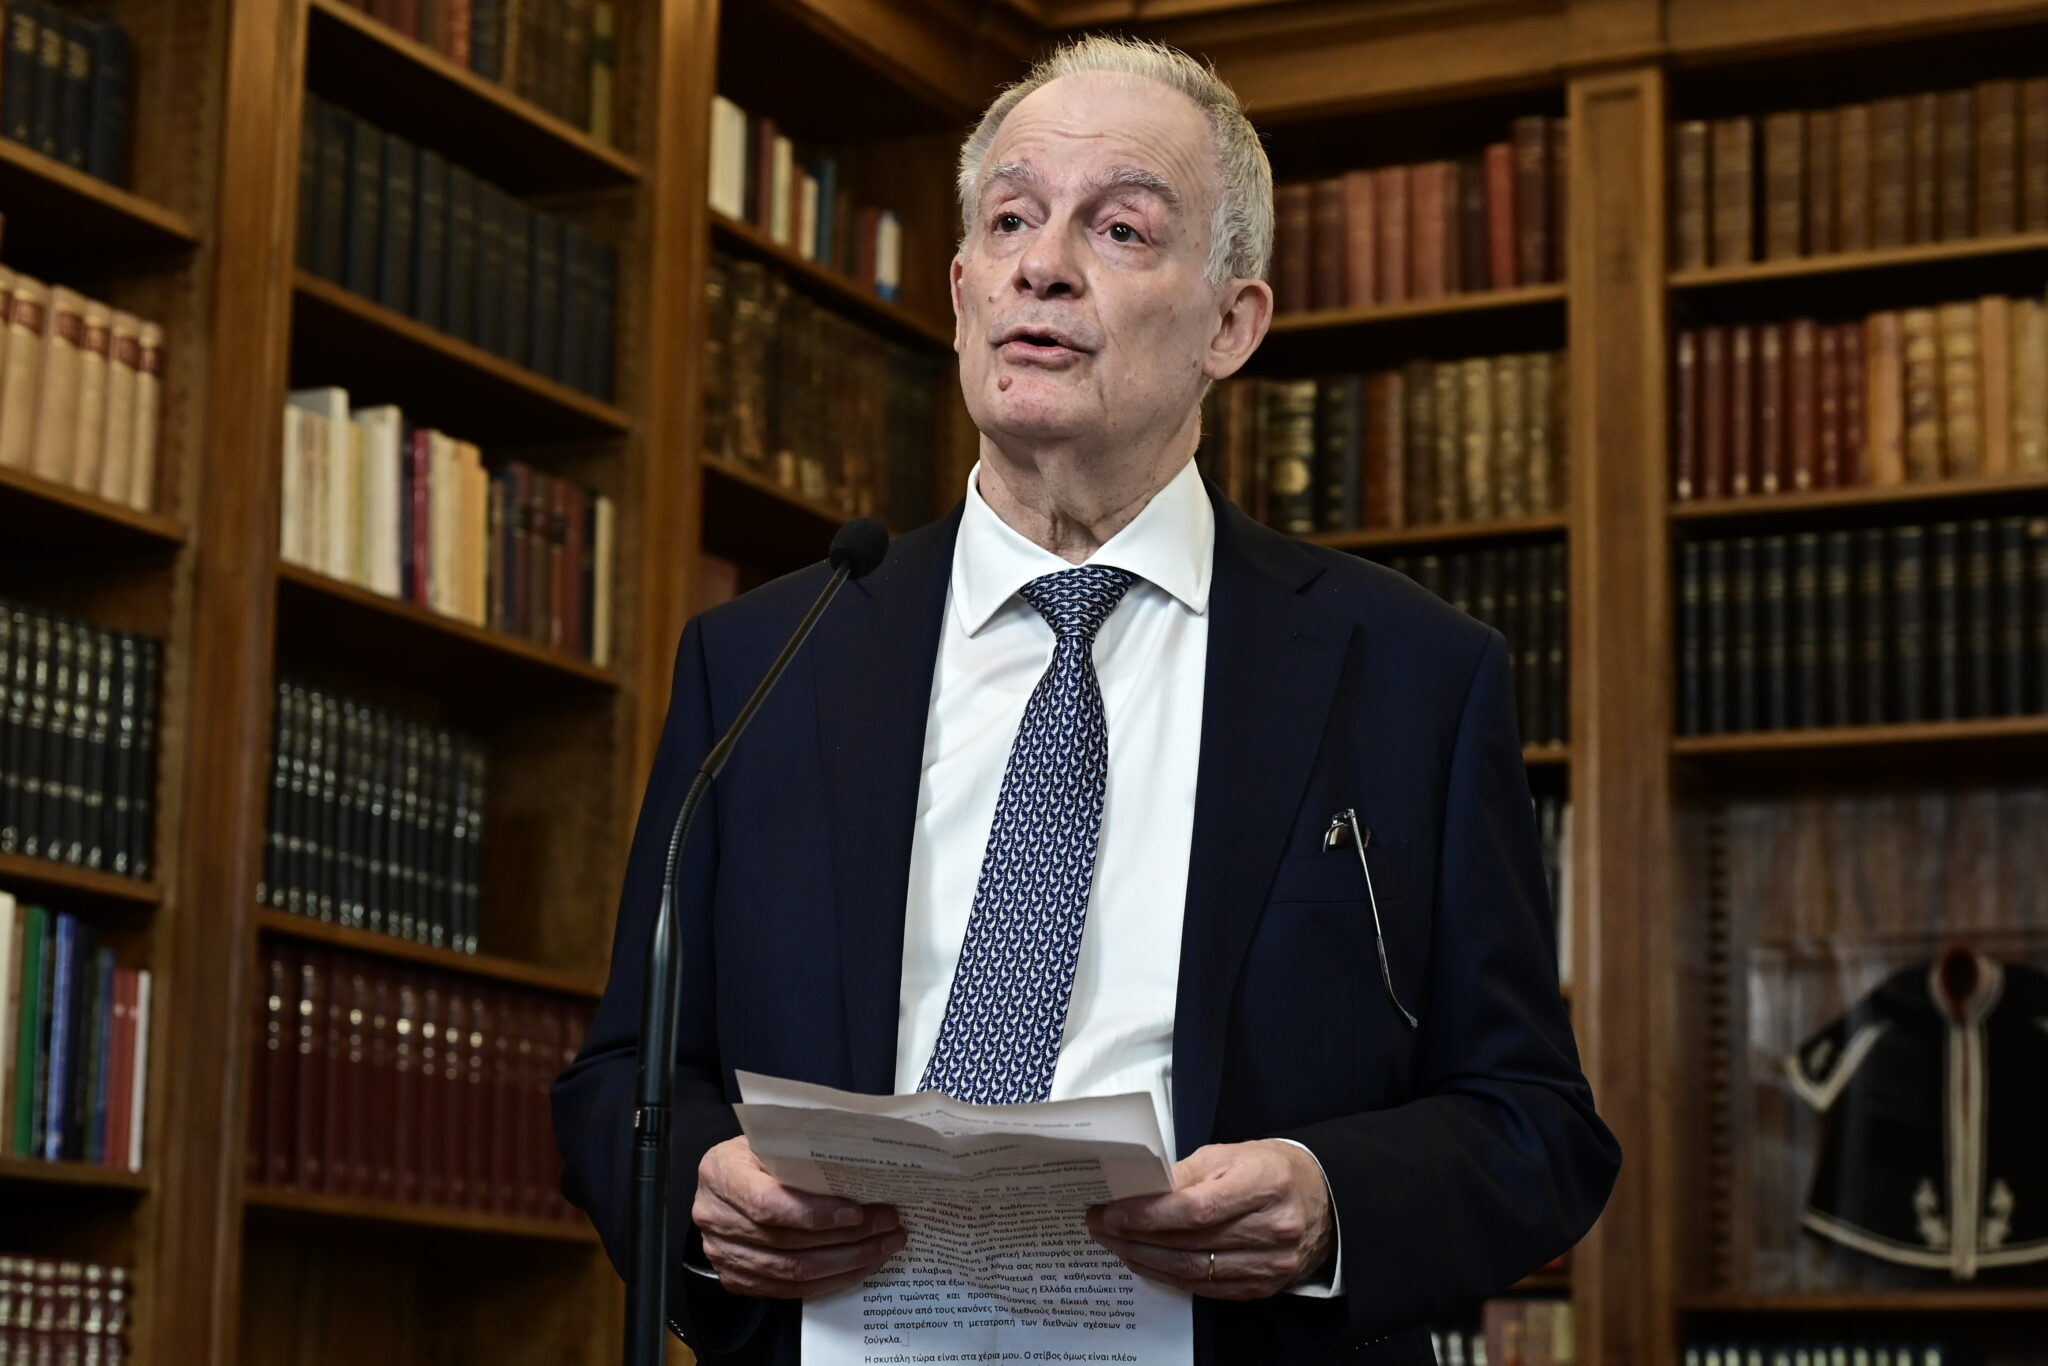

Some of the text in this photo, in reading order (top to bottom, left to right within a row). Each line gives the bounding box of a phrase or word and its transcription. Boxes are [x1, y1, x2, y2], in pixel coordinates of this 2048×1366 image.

[970, 1239, 987, 1247] στο
[974, 1244, 997, 1255] είναι
[1041, 1239, 1064, 1247] αλλά
[1066, 1239, 1082, 1248] την
[1022, 1248, 1071, 1259] λειτουργός
[1073, 1249, 1084, 1257] σε
[908, 1255, 921, 1264] για
[990, 1260, 1014, 1271] λόγια
[1016, 1262, 1033, 1271] σας
[1055, 1261, 1066, 1269] τα
[1068, 1259, 1099, 1269] κάνατε
[912, 1266, 953, 1276] ευλαβικά
[974, 1273, 1034, 1282] συνταγματικά
[1040, 1274, 1057, 1282] σας
[1063, 1271, 1111, 1281] καθήκοντα
[1118, 1273, 1133, 1281] και
[862, 1279, 911, 1289] περνώντας
[912, 1279, 935, 1288] προς
[948, 1278, 965, 1288] έξω
[1012, 1286, 1030, 1295] πως
[1031, 1287, 1038, 1295] η
[1039, 1284, 1072, 1294] Ελλάδα
[1074, 1284, 1117, 1294] επιδιώκει
[1118, 1286, 1134, 1295] την
[863, 1293, 893, 1303] ειρήνη
[899, 1292, 940, 1302] τιμώντας
[946, 1291, 961, 1300] και
[967, 1291, 1037, 1306] προστατεύοντας
[1095, 1299, 1111, 1307] της
[863, 1303, 1136, 1318] απορρέουν από τους κανόνες του διεθνούς δικαίου, που μόνον
[863, 1318, 1137, 1331] αυτοί αποτρέπουν τη μετατροπή των διεθνών σχέσεων σε
[864, 1351, 1137, 1364] Η σκυτάλη τώρα είναι στα χέρια μου. Ο στίβος όμως είναι πλέον
